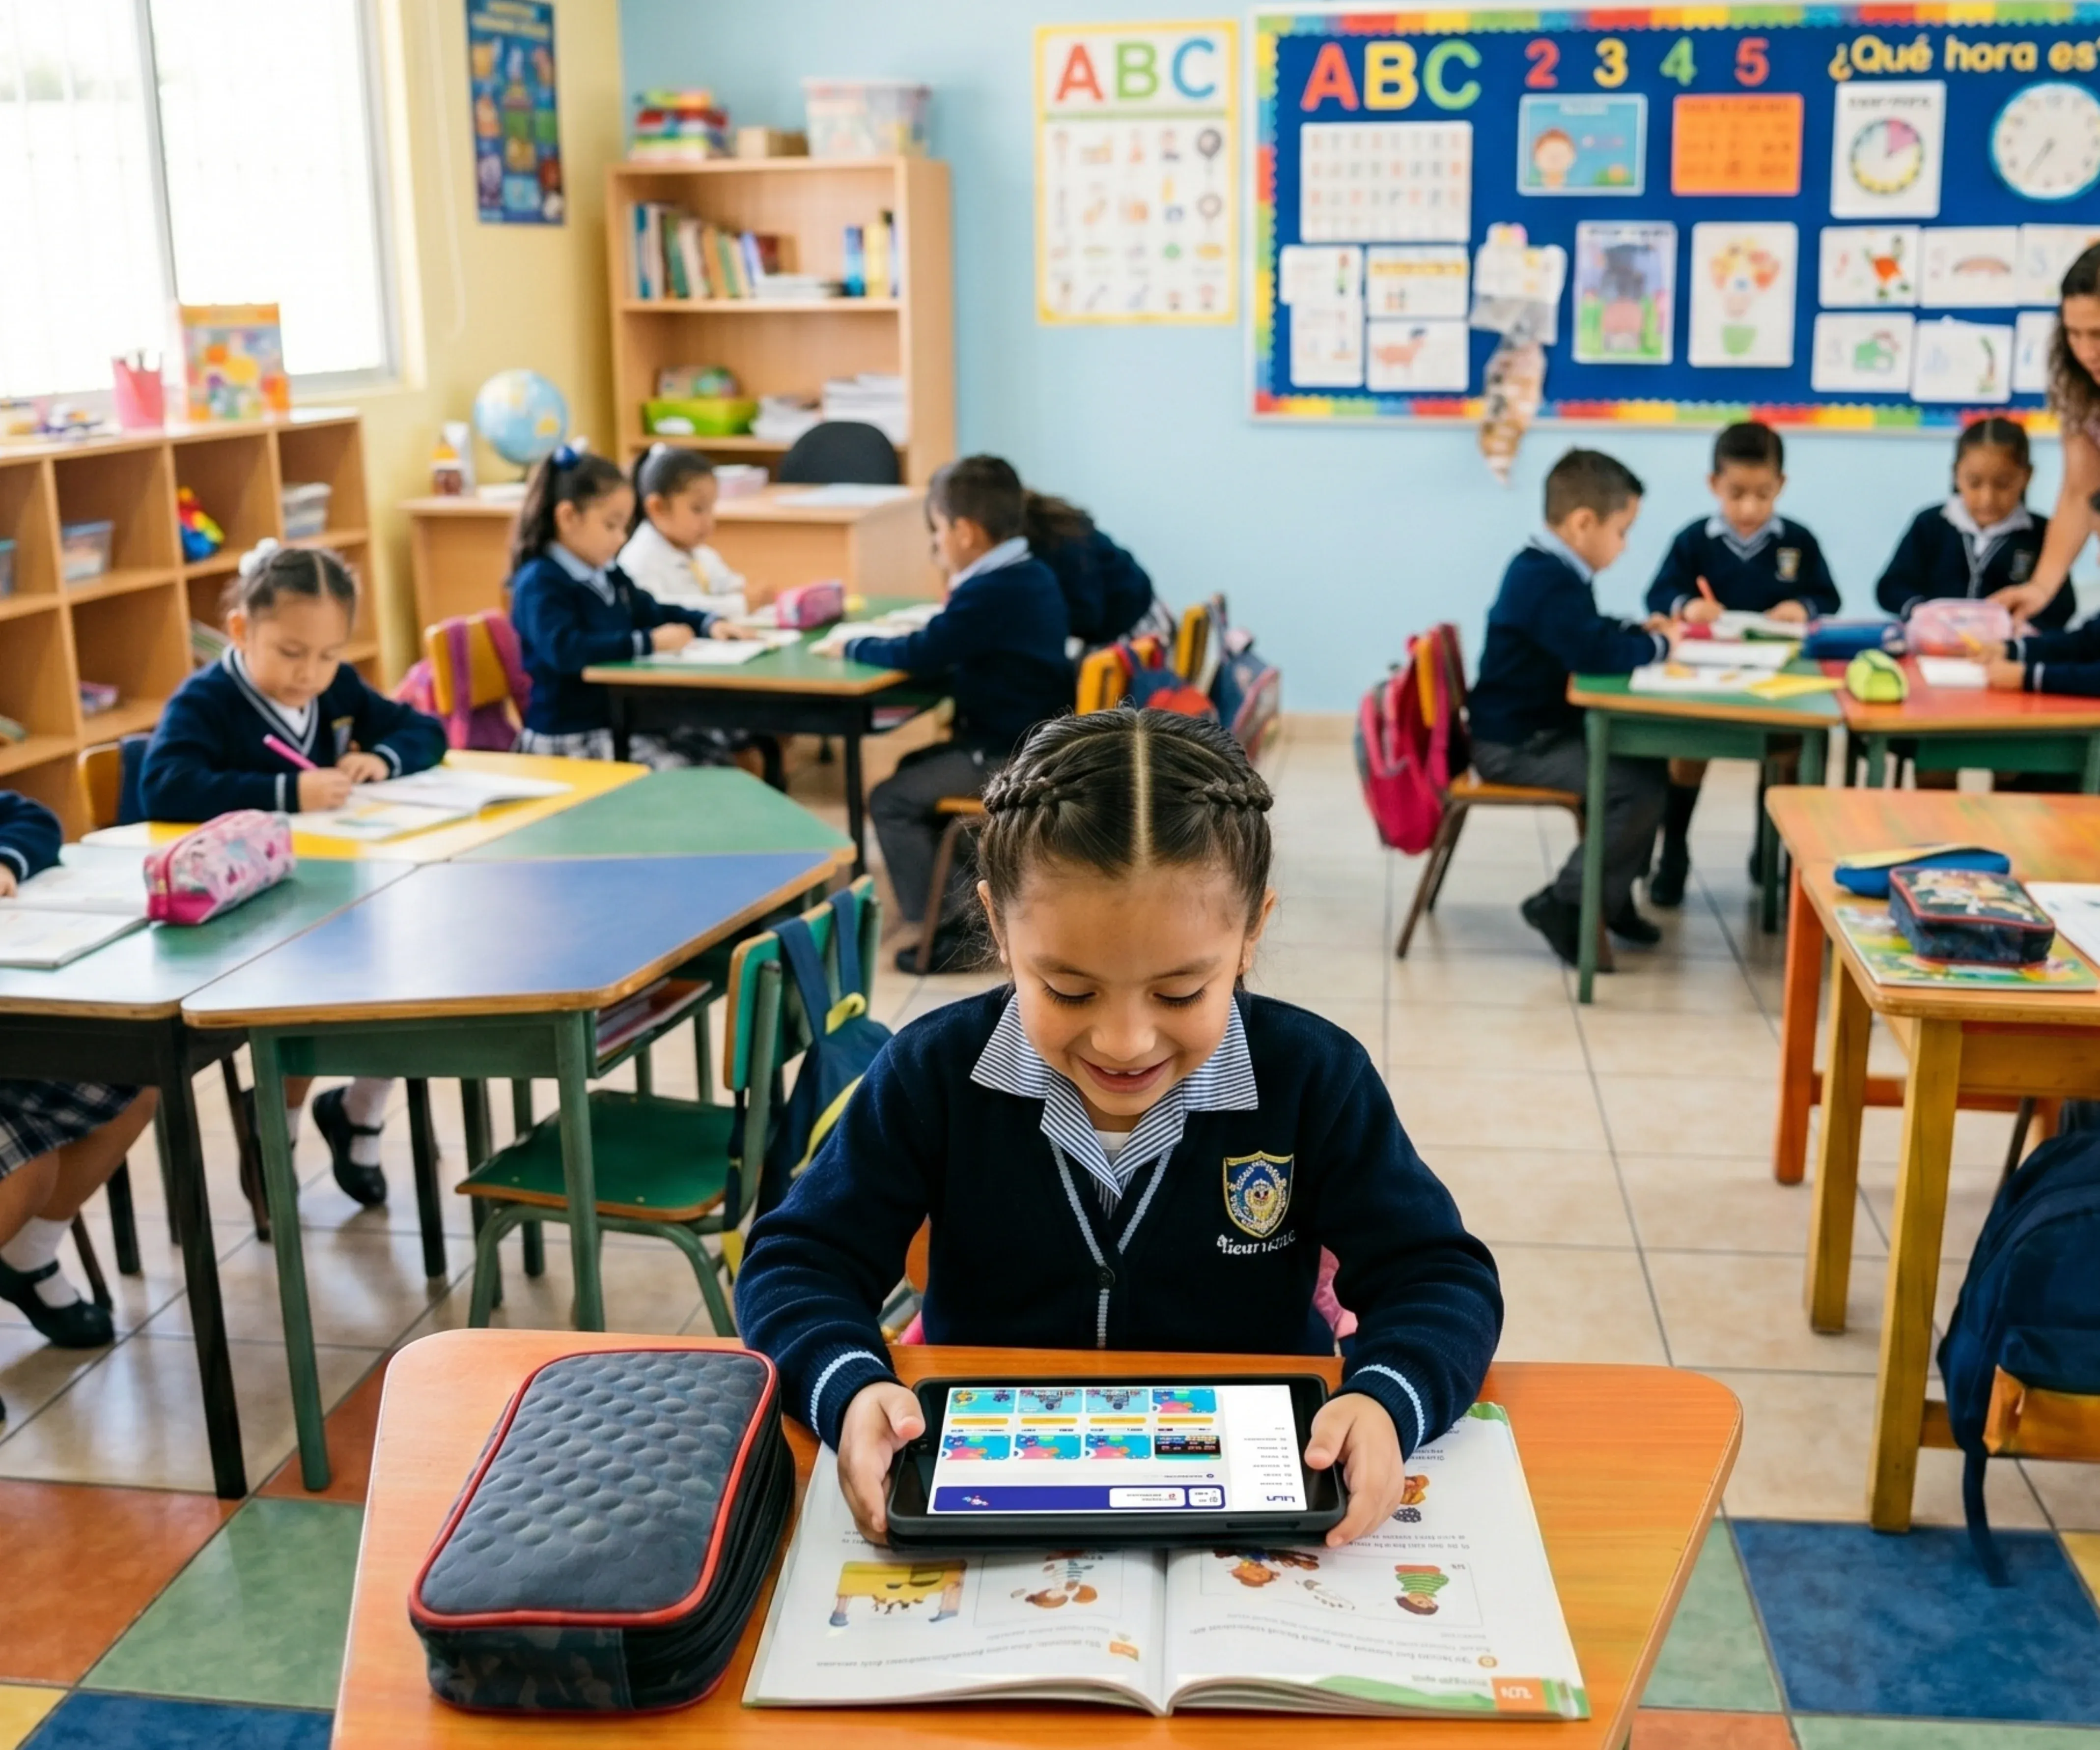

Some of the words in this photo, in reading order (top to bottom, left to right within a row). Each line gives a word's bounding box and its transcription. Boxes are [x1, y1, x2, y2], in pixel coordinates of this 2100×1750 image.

[1056, 37, 1217, 103] ABC
[1299, 39, 1482, 112] ABC
[1525, 39, 1560, 88] 2
[1593, 37, 1628, 88] 3
[1660, 36, 1697, 86] 4
[1735, 36, 1769, 86] 5
[1828, 33, 1933, 82] ¿Qué
[1944, 33, 2038, 72] hora
[2048, 34, 2100, 73] es
